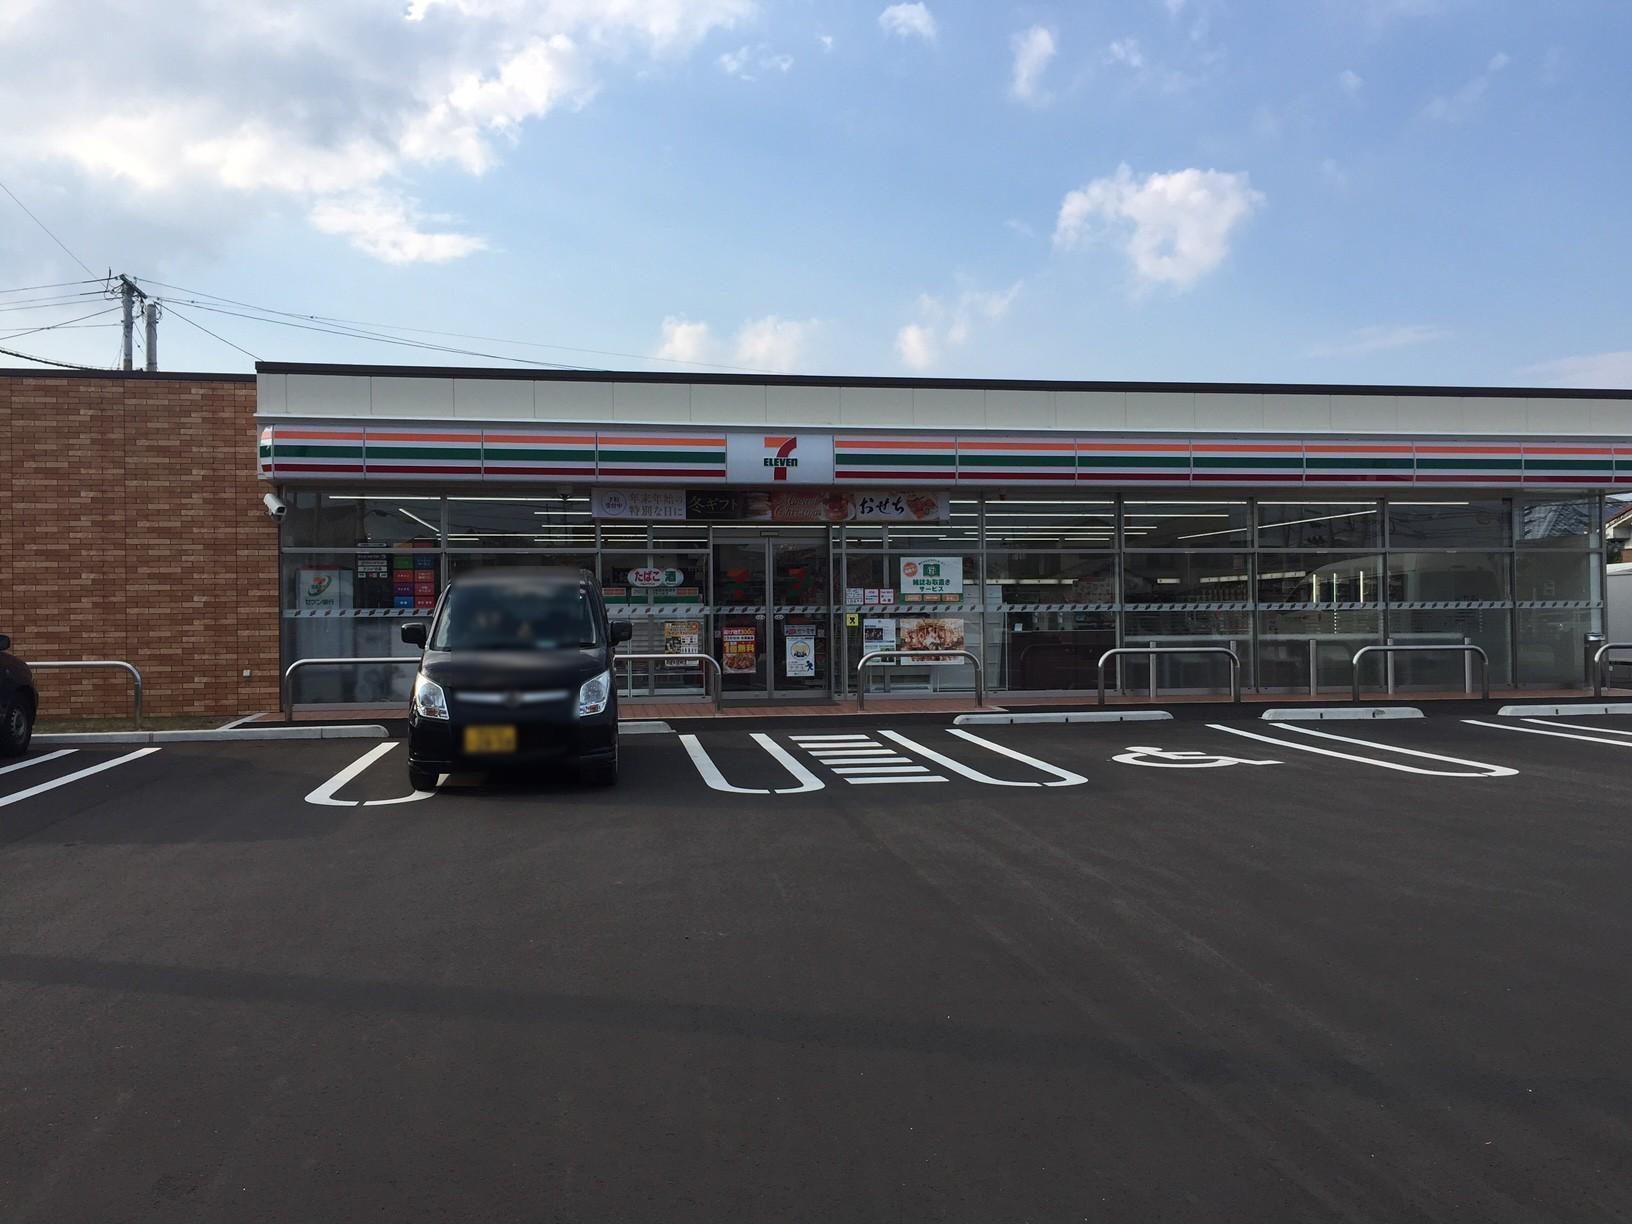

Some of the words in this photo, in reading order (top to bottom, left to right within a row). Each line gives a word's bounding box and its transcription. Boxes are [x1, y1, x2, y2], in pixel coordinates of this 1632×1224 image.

[690, 495, 738, 513] 冬ギフト
[859, 496, 904, 514] おせち
[634, 571, 660, 582] たばこ
